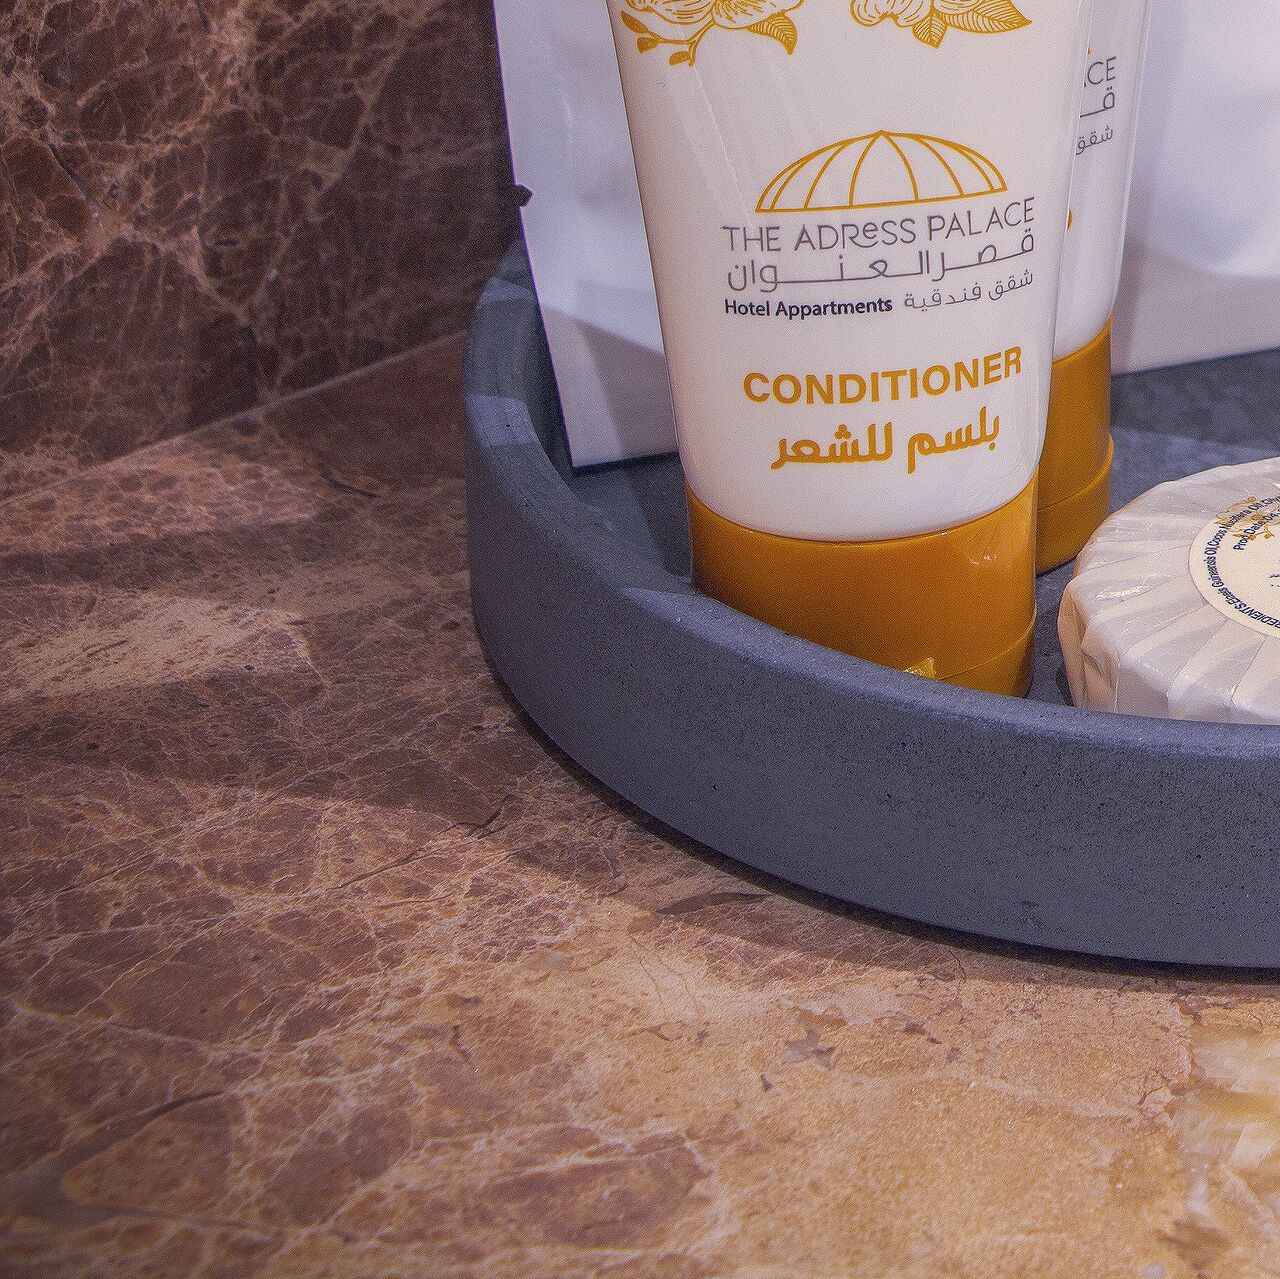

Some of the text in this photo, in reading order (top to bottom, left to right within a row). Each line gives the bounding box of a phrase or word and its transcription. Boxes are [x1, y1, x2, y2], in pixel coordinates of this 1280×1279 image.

[721, 225, 782, 252] THE
[928, 196, 1036, 241] PALACE
[727, 228, 1035, 293] قصر العنوان
[725, 297, 893, 320] Hotel Appartments
[904, 269, 1034, 312] شقق فندقية
[743, 346, 1023, 405] CONDITIONER
[770, 406, 1001, 475] بلسم للشعر
